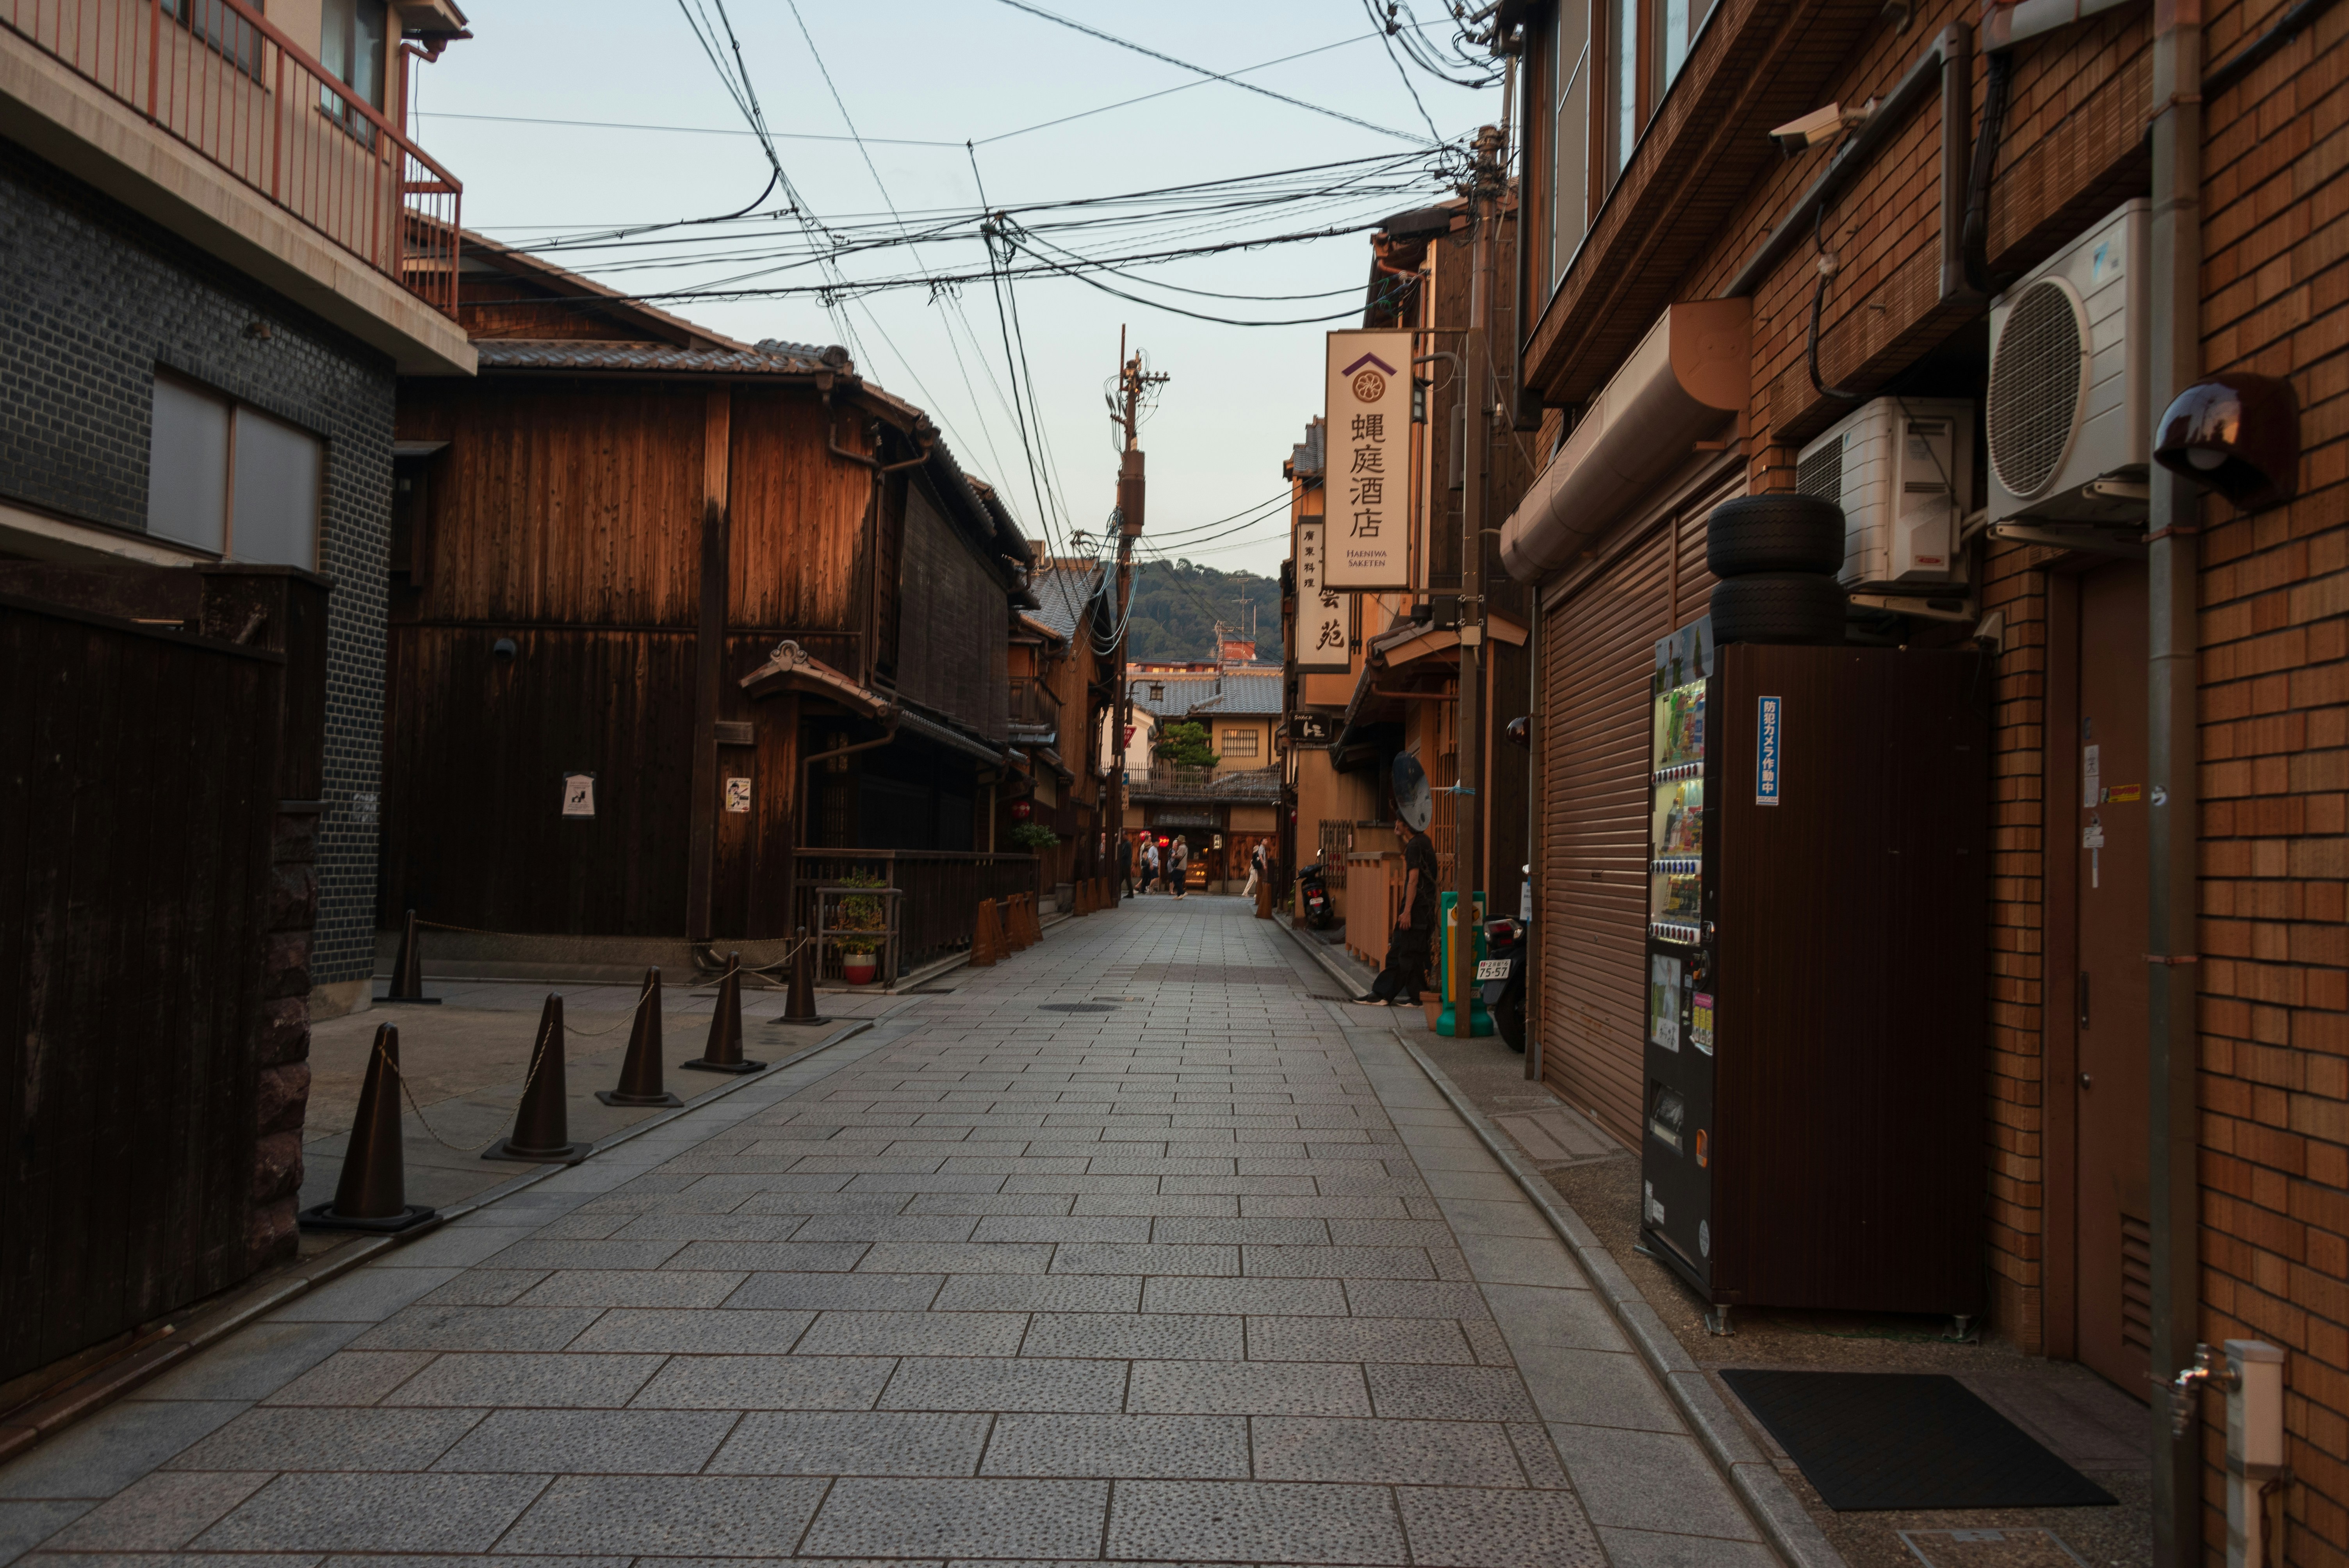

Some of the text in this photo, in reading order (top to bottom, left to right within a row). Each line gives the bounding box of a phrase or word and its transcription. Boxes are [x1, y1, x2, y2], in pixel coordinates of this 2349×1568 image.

[1303, 530, 1315, 588] 廣東料理
[1348, 559, 1386, 567] SAKETEN
[1761, 701, 1776, 794] 防犯カメラ作動中
[1480, 967, 1508, 978] 75-57
